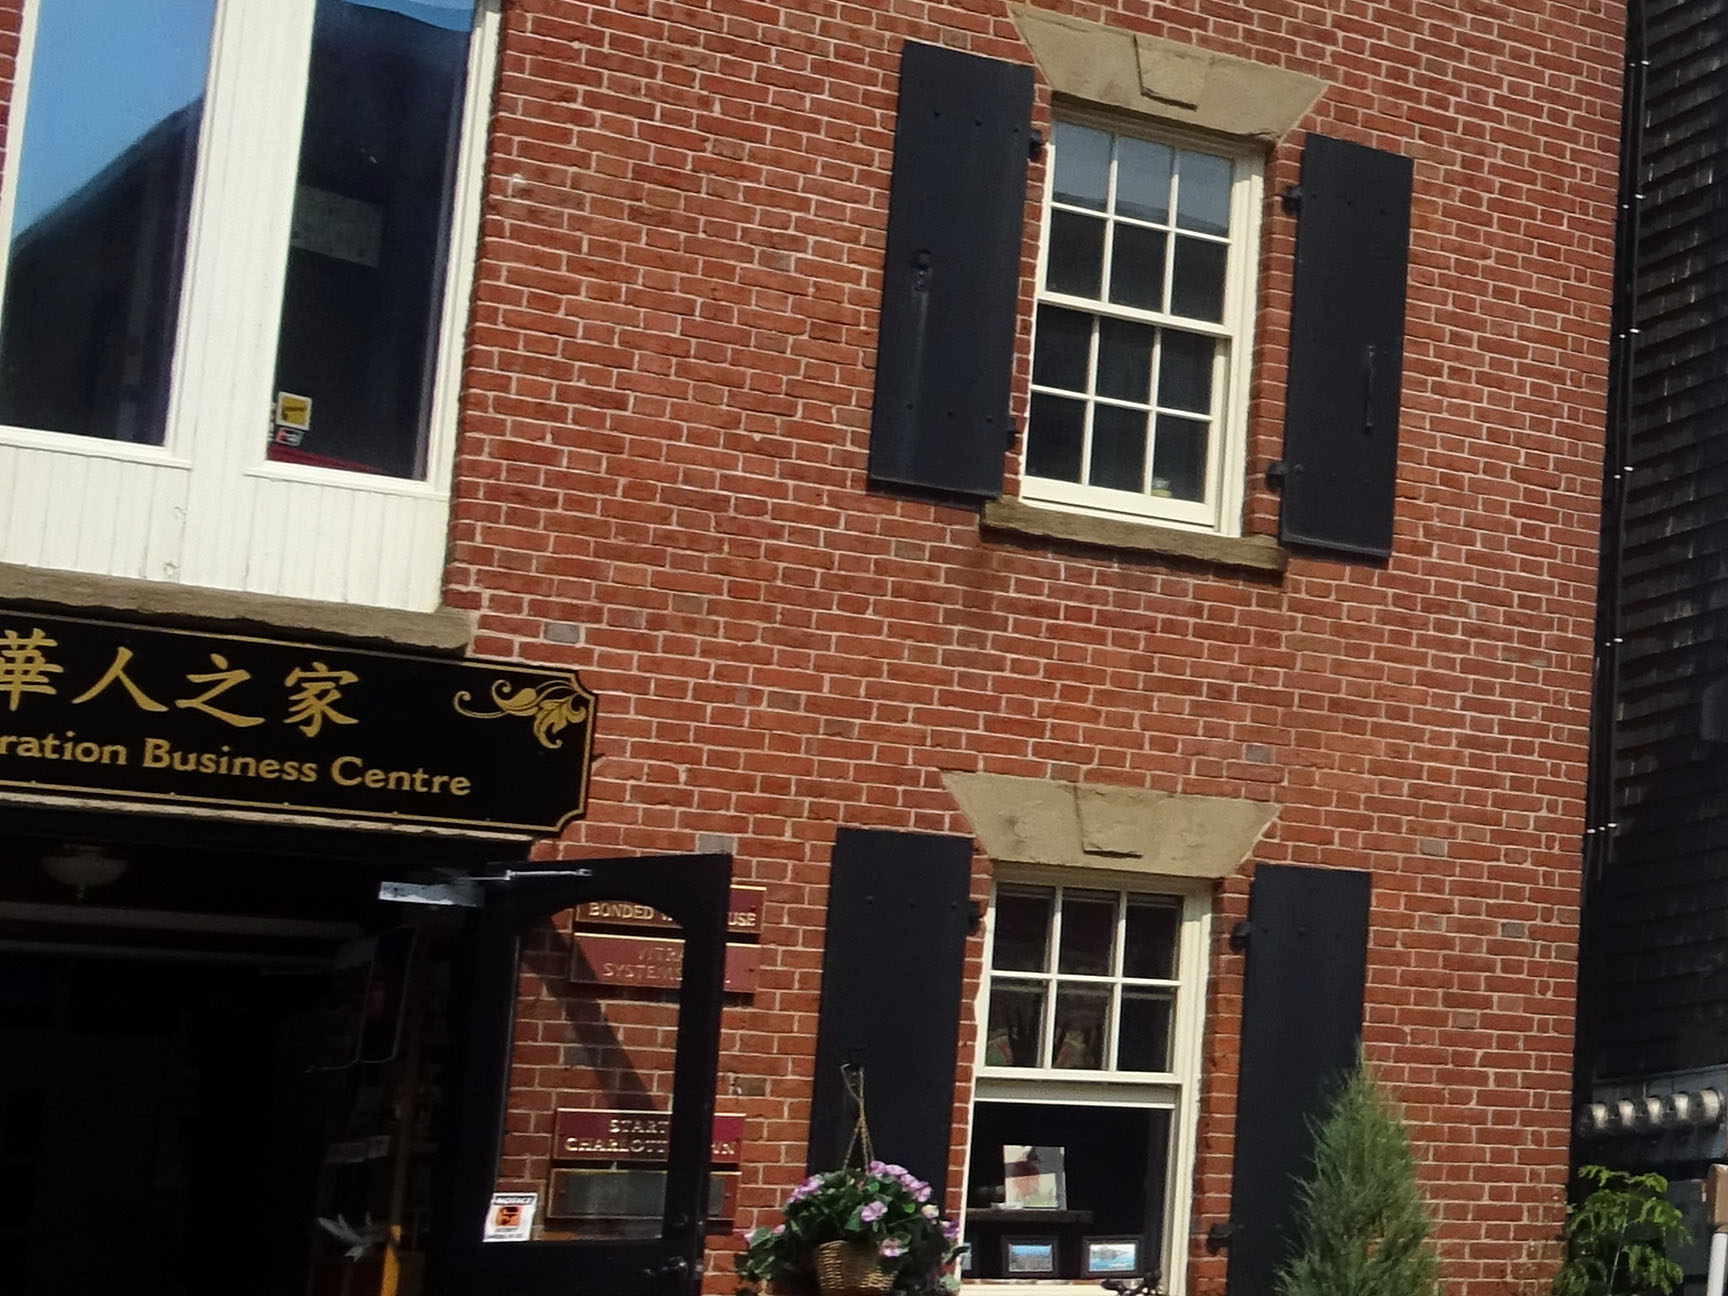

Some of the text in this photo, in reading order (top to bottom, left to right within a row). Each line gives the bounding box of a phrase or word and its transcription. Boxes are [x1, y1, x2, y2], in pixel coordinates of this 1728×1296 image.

[143, 738, 318, 782] Business
[331, 756, 471, 795] Centre
[588, 902, 654, 920] BONDED
